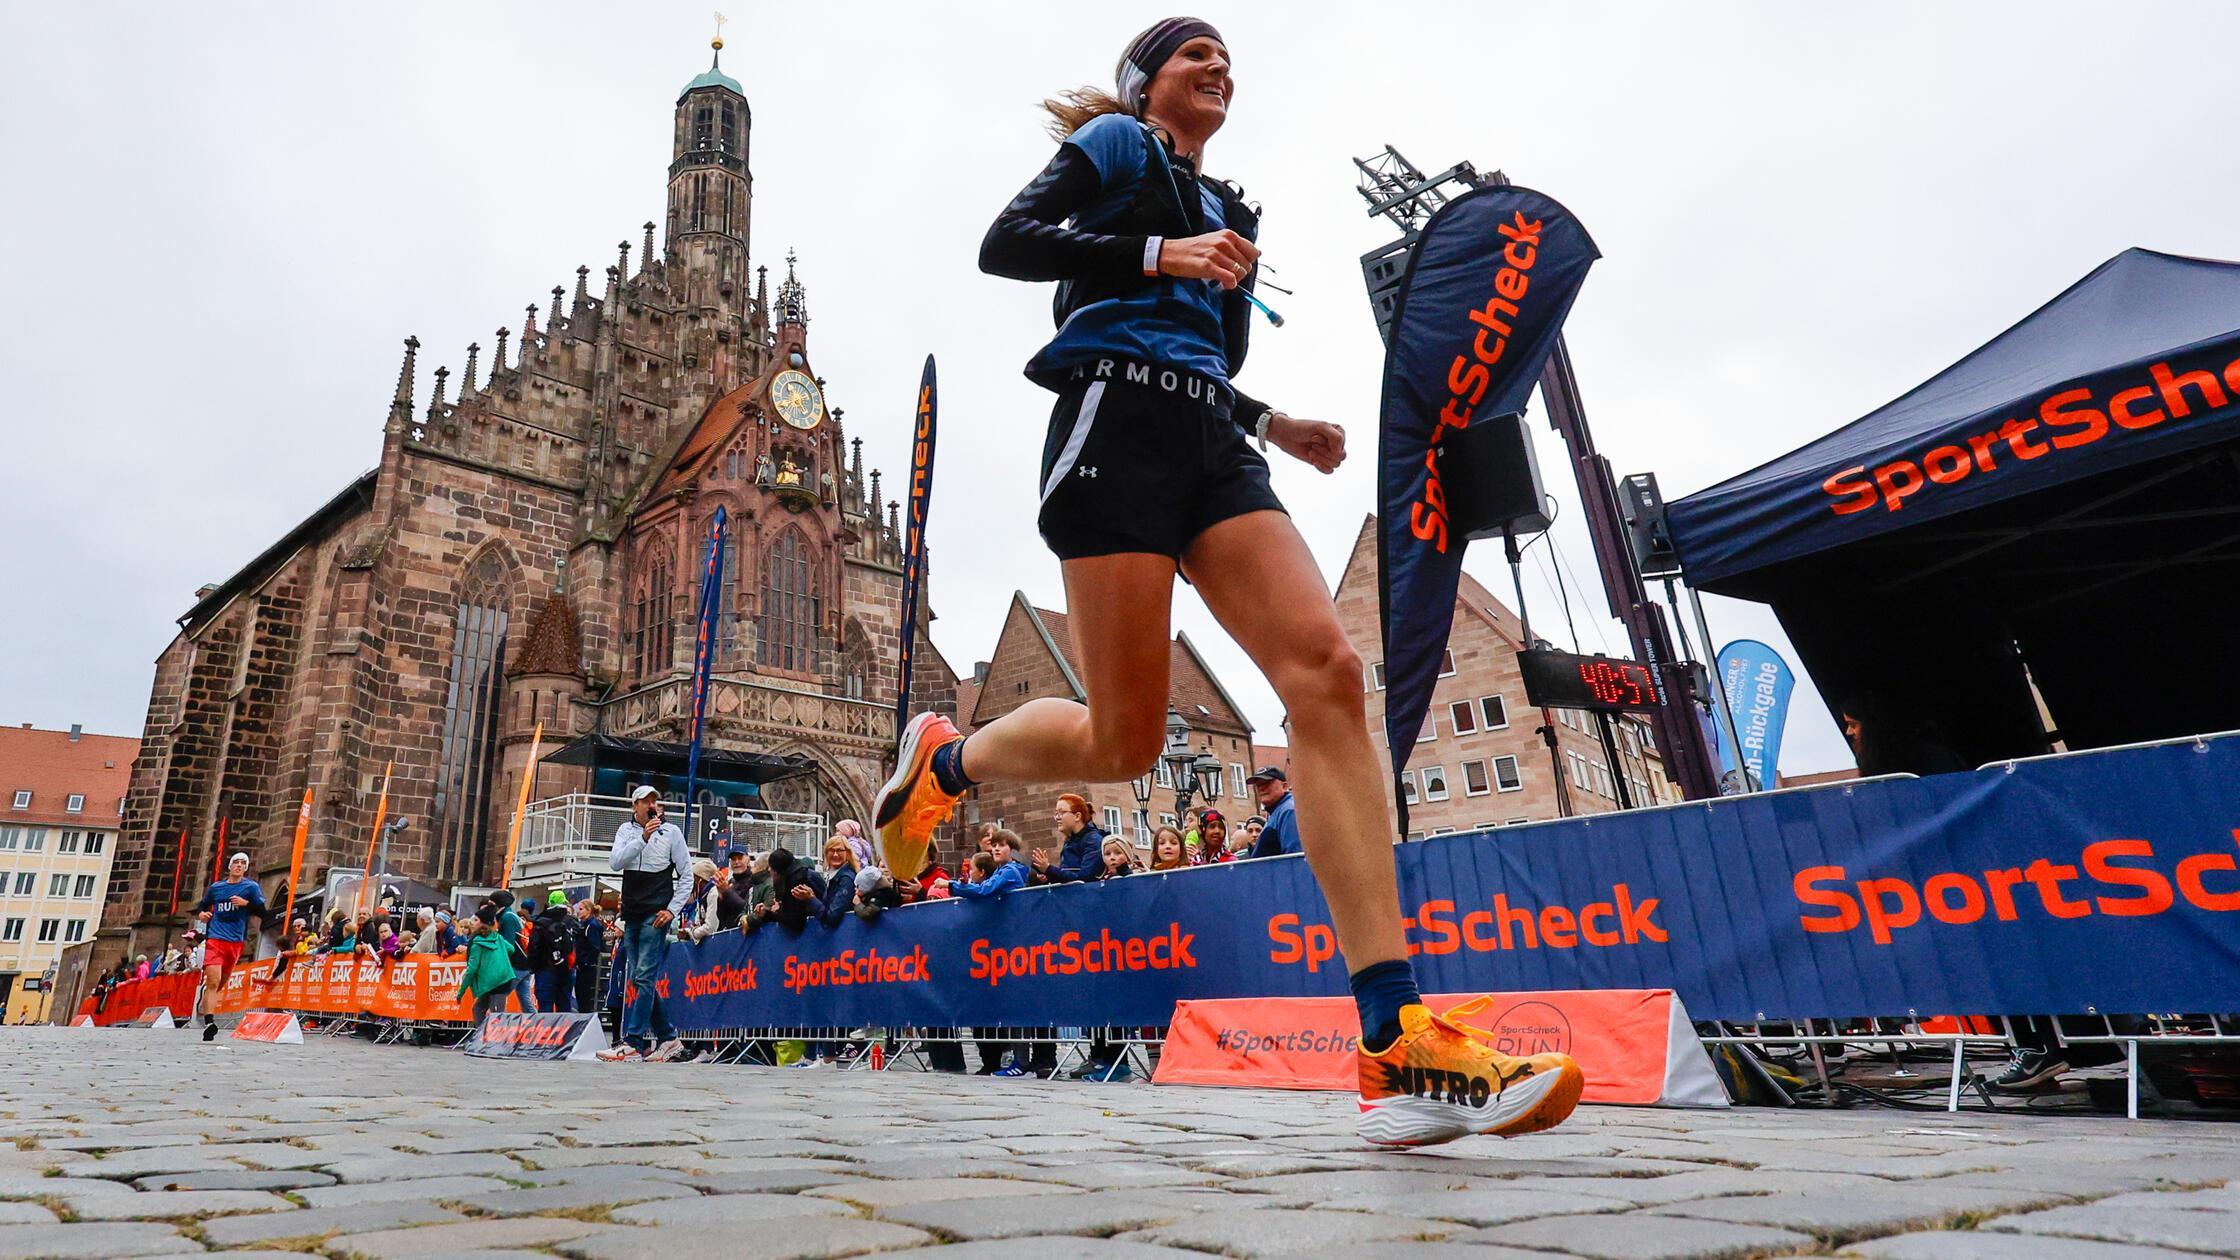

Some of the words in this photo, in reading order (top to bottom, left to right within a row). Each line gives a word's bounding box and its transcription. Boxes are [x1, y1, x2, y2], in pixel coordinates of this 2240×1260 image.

[1070, 358, 1216, 406] ARMOUR
[1643, 638, 1656, 662] TOWER
[1580, 662, 1656, 705] 40:57
[1650, 662, 1663, 686] SUPER
[1793, 828, 2240, 945] SportSc
[330, 960, 354, 983] DAK
[358, 960, 383, 983] DAK
[391, 961, 418, 986] DAK
[783, 944, 930, 995] SportScheck
[970, 922, 1197, 986] SportScheck
[684, 959, 757, 1003] SportScheck
[1500, 1025, 1561, 1036] SportScheck
[1376, 1061, 1491, 1109] NITRO
